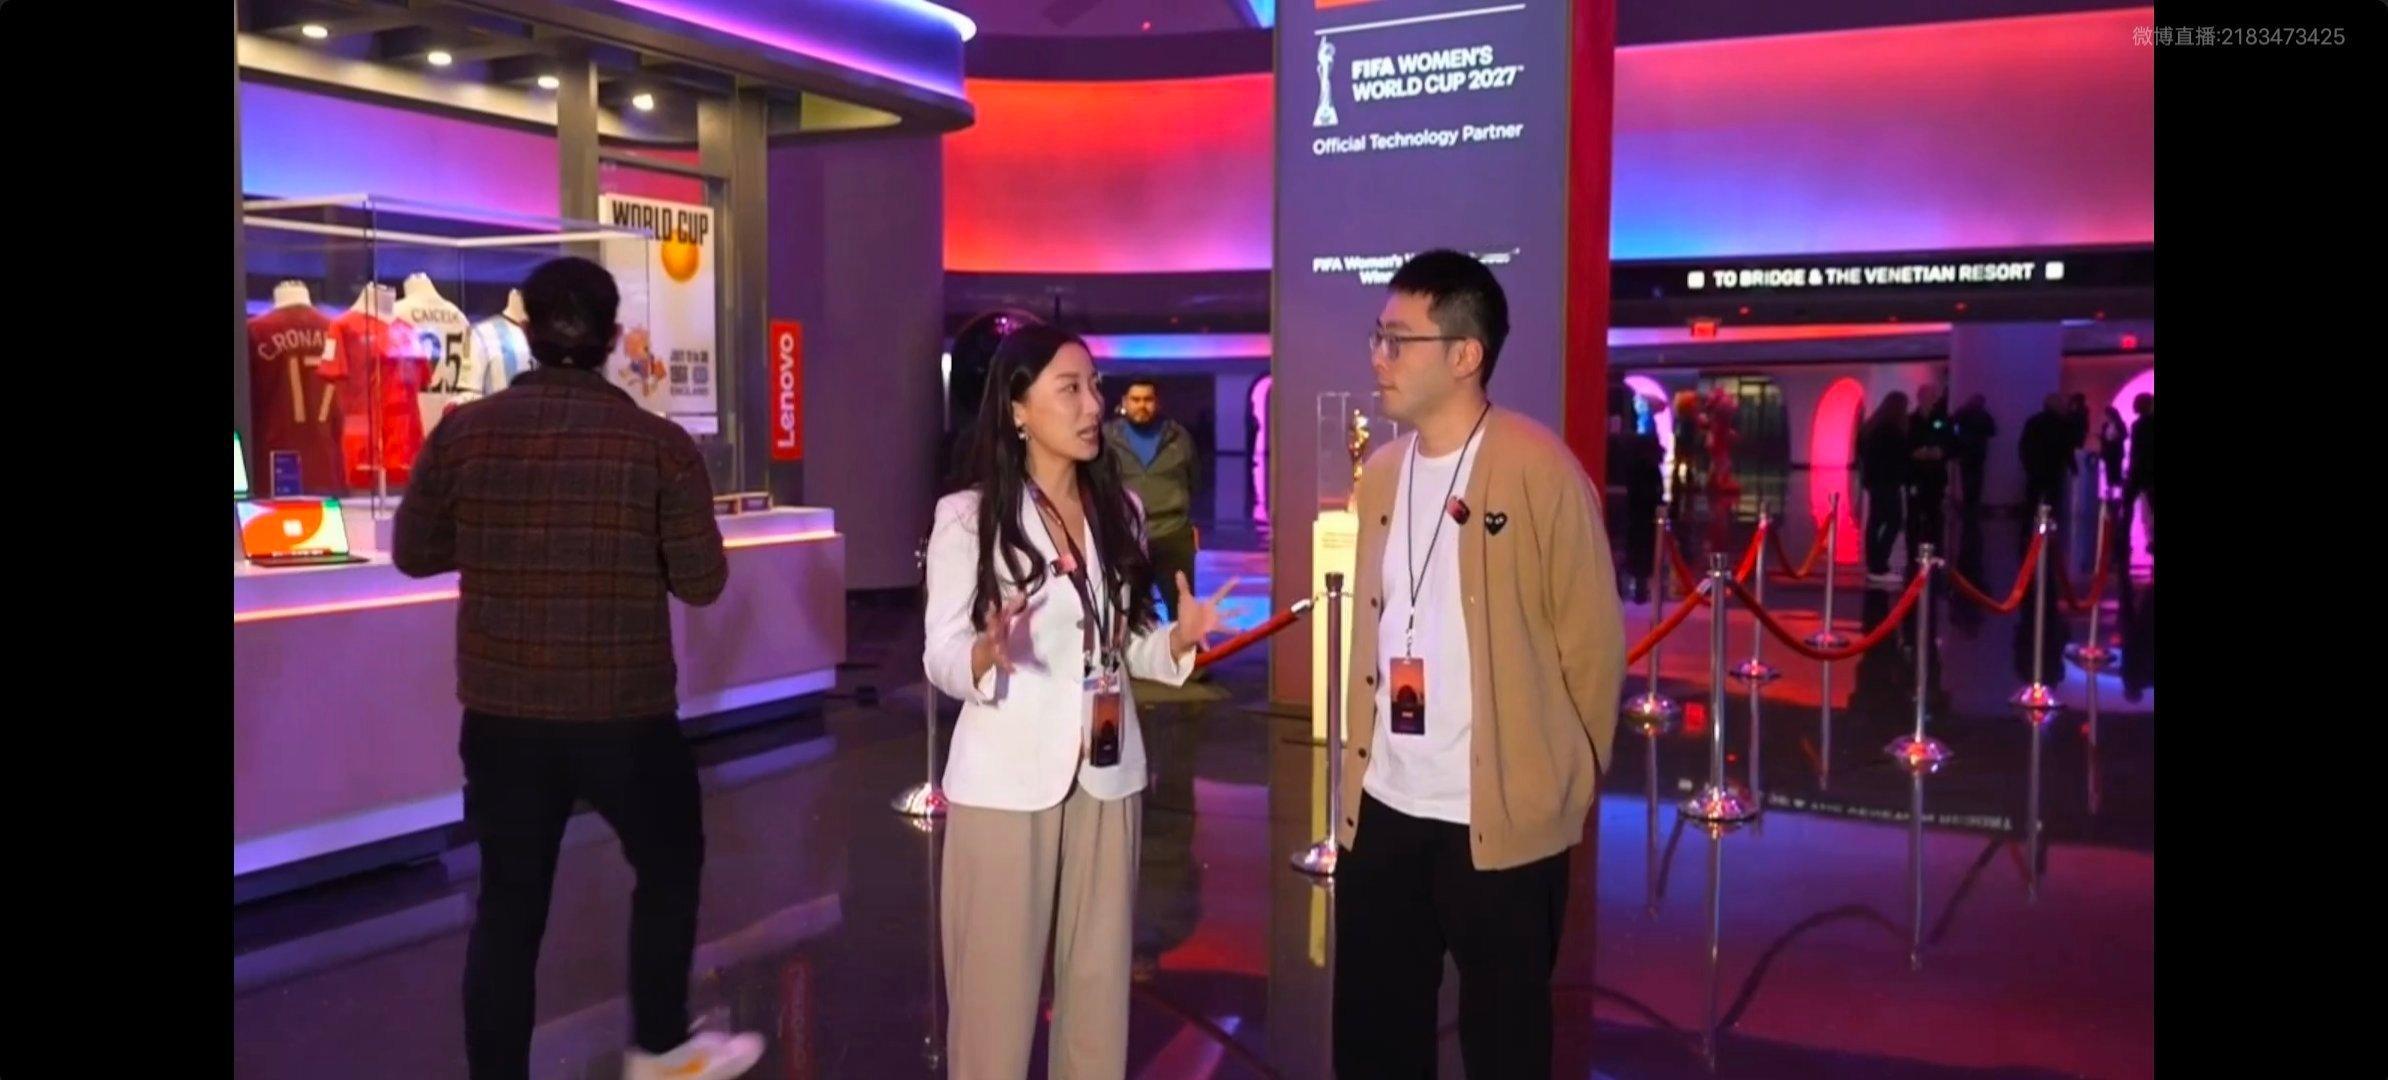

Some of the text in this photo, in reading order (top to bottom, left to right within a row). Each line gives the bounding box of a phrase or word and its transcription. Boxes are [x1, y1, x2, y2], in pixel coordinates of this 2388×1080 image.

[1351, 45, 1493, 80] FIFA WOMEN'S
[1353, 76, 1422, 102] WORLD
[1424, 72, 1466, 95] CUP
[1313, 123, 1524, 155] Official Technology Partner
[612, 199, 709, 246] WORLD CUP
[1713, 262, 2035, 288] TO BRIDGE & THE VENETIAN RESORT
[289, 355, 336, 423] 17
[778, 332, 795, 448] Lenovo
